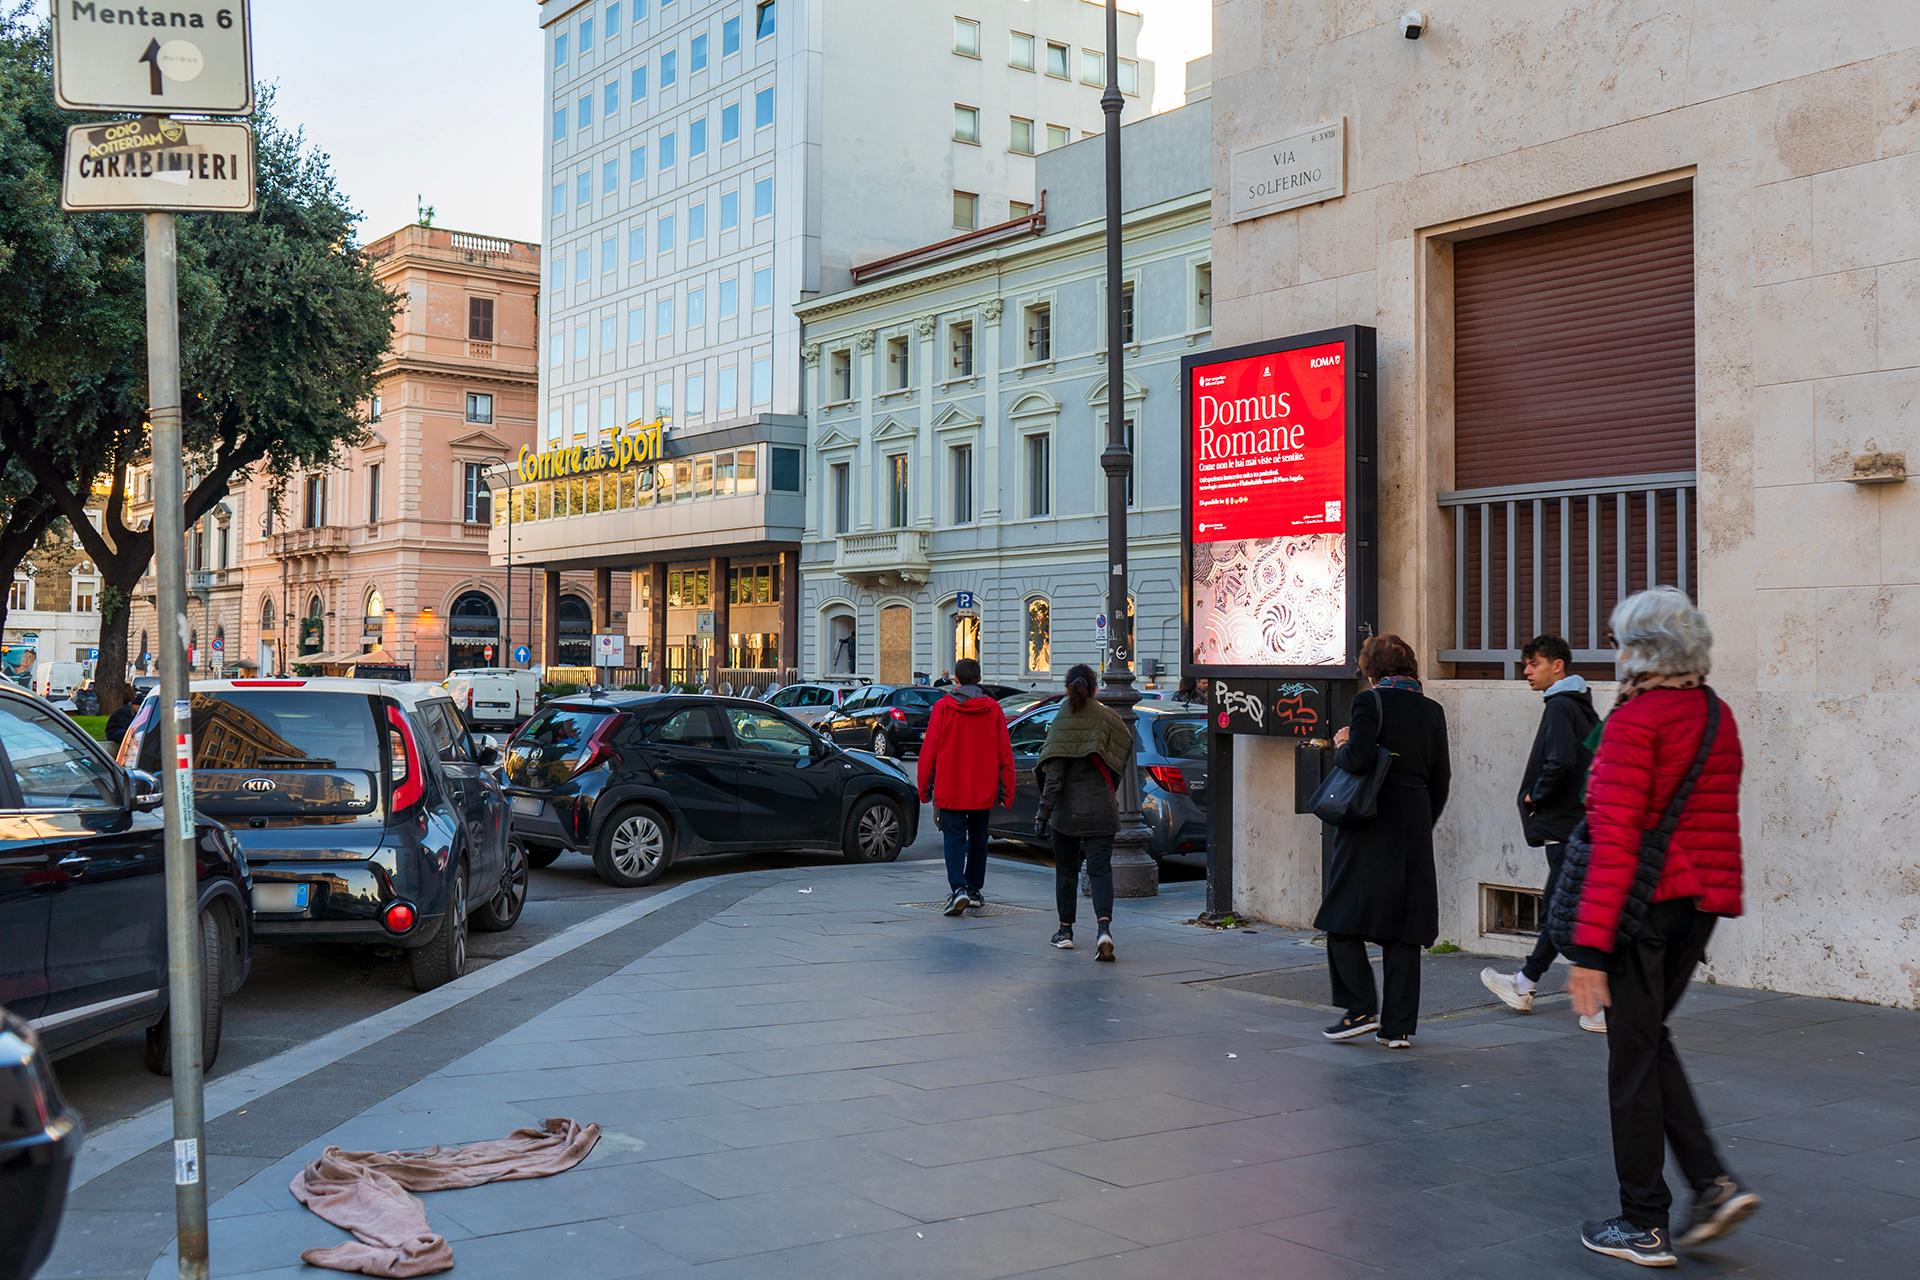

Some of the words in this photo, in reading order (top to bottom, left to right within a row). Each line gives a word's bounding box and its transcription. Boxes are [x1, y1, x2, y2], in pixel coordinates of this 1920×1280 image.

[72, 1, 204, 28] Mentana
[216, 9, 233, 29] 6
[105, 121, 141, 140] ODIO
[88, 132, 164, 158] ROTTERDAM
[1273, 151, 1296, 166] VIA
[80, 151, 237, 180] CARABINIERI
[1248, 168, 1322, 200] SOLFERINO
[1310, 356, 1335, 369] ROMA
[1199, 392, 1291, 429] Domus
[517, 442, 583, 482] Corriere
[583, 448, 606, 472] dello
[609, 416, 664, 472] Sport
[1199, 423, 1305, 461] Romane
[1198, 462, 1216, 472] Come
[1216, 462, 1229, 470] non
[1235, 458, 1245, 468] hai
[1245, 457, 1258, 467] mai
[1258, 455, 1273, 465] viste
[1273, 453, 1281, 464] né
[248, 781, 271, 791] KIA
